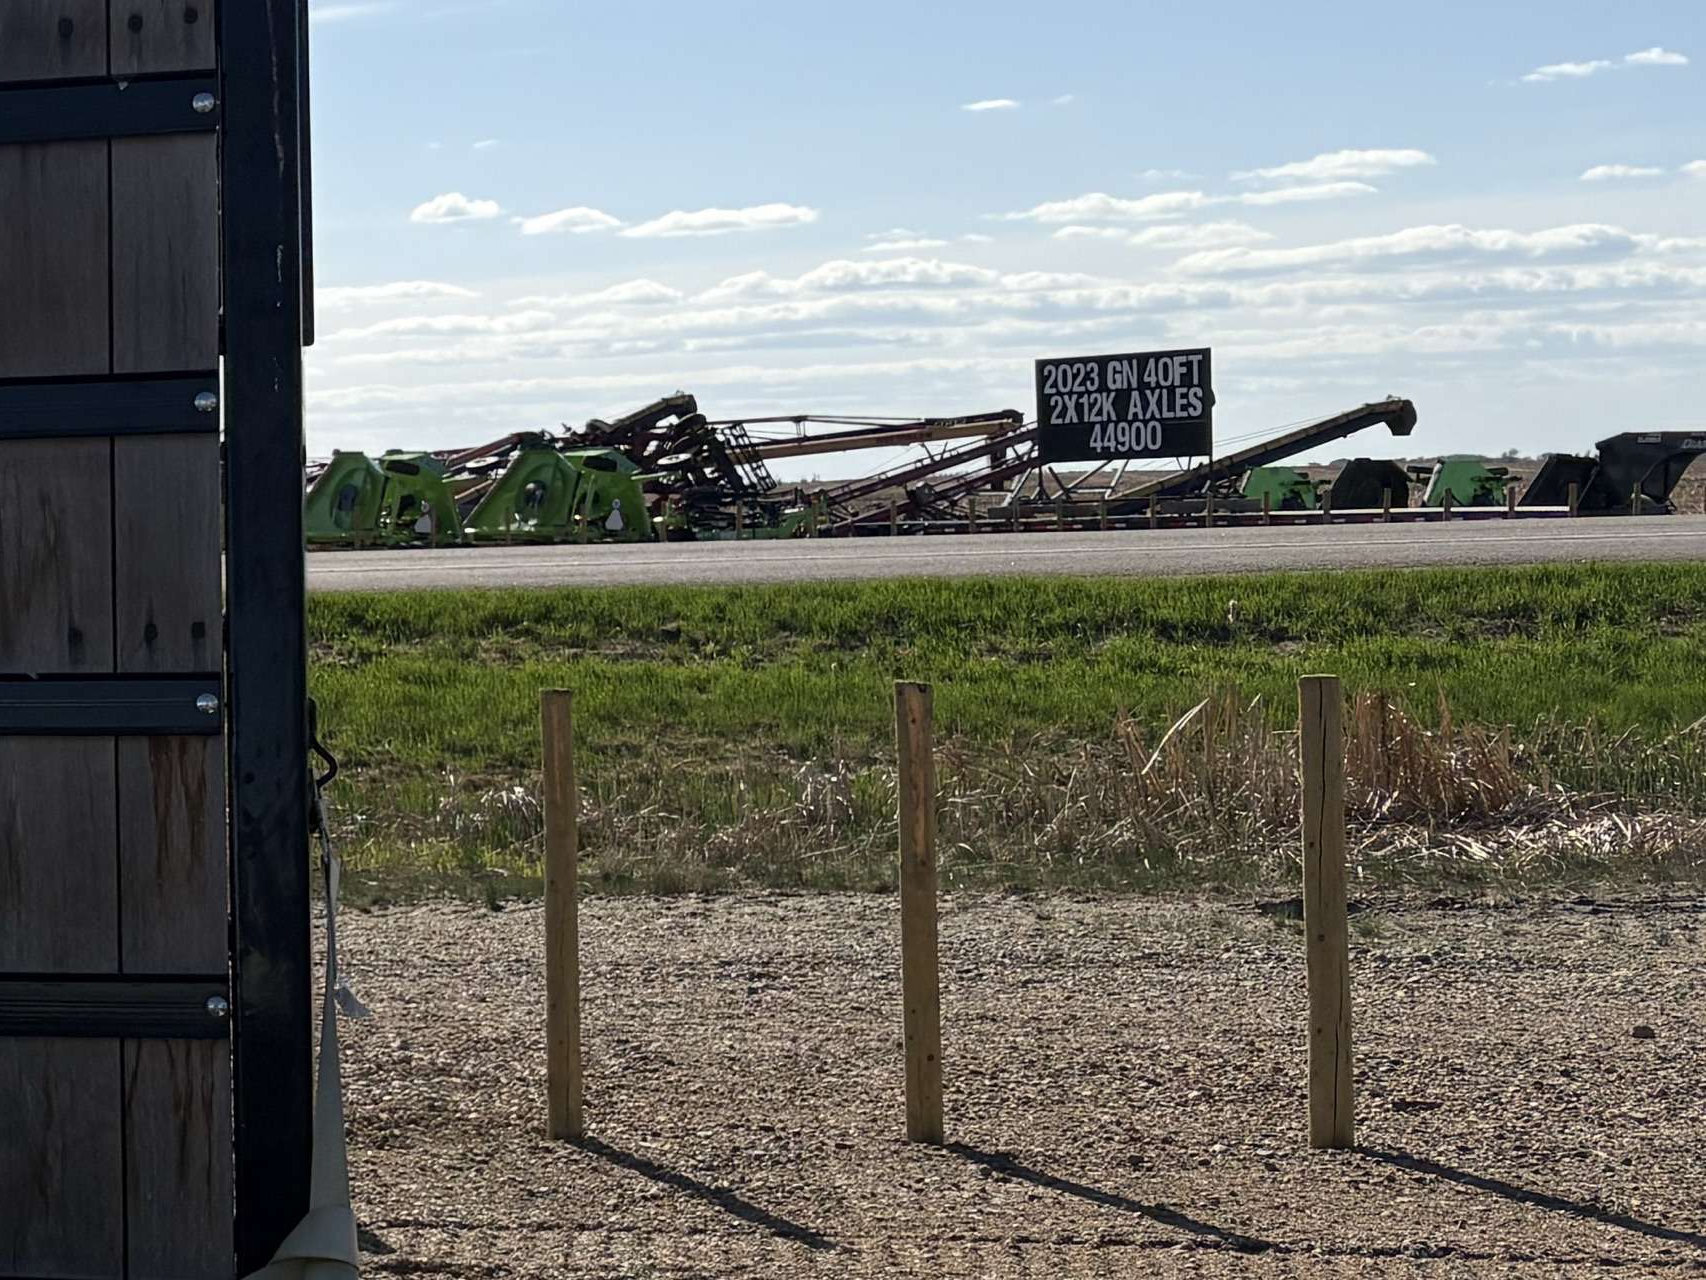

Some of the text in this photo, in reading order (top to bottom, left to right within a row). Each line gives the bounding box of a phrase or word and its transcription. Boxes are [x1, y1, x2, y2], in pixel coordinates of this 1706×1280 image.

[1043, 354, 1203, 394] 2023 GN 40FT
[1050, 387, 1203, 425] 2X12K AXLES
[1090, 420, 1162, 453] 44900
